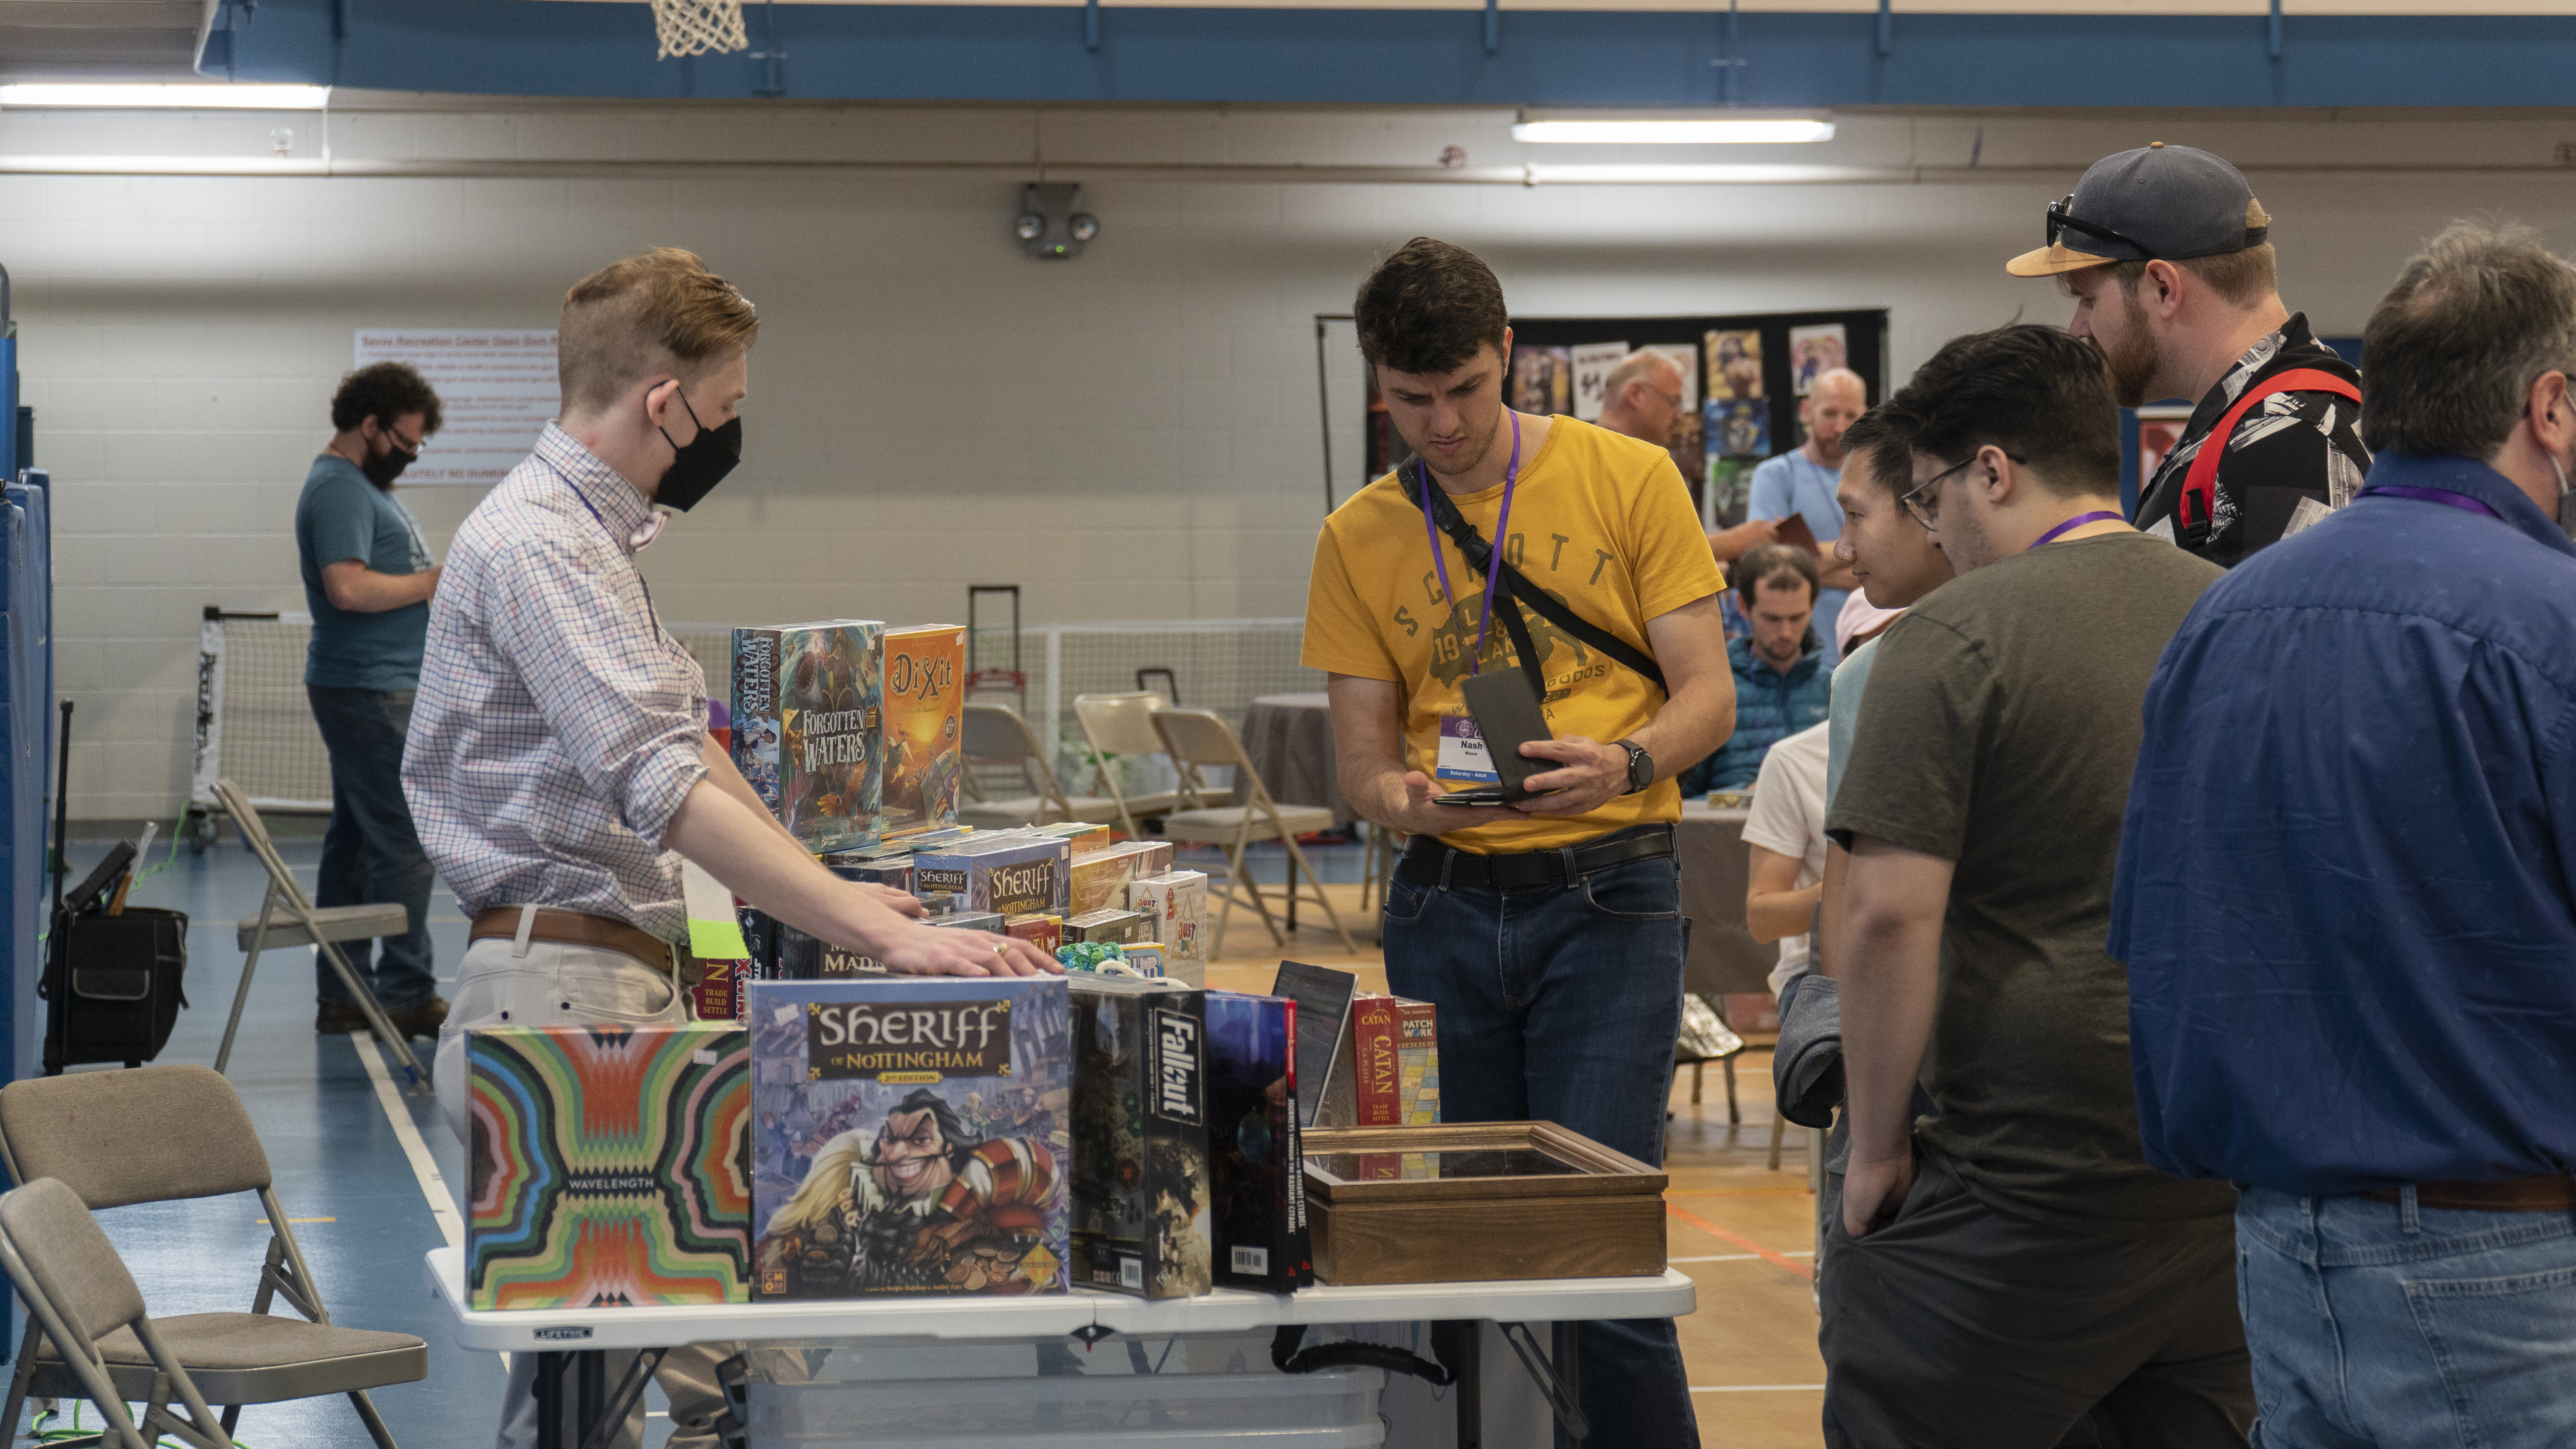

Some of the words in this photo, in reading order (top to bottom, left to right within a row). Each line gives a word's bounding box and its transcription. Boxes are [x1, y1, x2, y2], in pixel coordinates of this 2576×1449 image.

[741, 639, 759, 713] WATERS
[759, 637, 773, 712] FORGOTTEN
[803, 709, 864, 735] FORGOTTEN
[803, 731, 865, 773] WATERS
[1461, 740, 1482, 750] Nash
[1002, 897, 1045, 914] NOTTINGHAM
[1138, 898, 1157, 907] JUST
[1178, 922, 1197, 941] JUST
[705, 988, 728, 997] TRADE
[705, 997, 726, 1006] BUILD
[1362, 1015, 1391, 1025] CATAN
[1403, 1019, 1433, 1029] PATCH
[1403, 1028, 1433, 1038] WORK
[831, 1056, 844, 1066] OF
[846, 1052, 983, 1070] NOTTINGHAM
[1162, 1017, 1195, 1116] Fallout
[1373, 1035, 1393, 1094] CATAN
[568, 1177, 654, 1190] WAVELENGTH
[1297, 1200, 1306, 1228] CITADEL
[540, 1328, 587, 1339] LIFETIME
